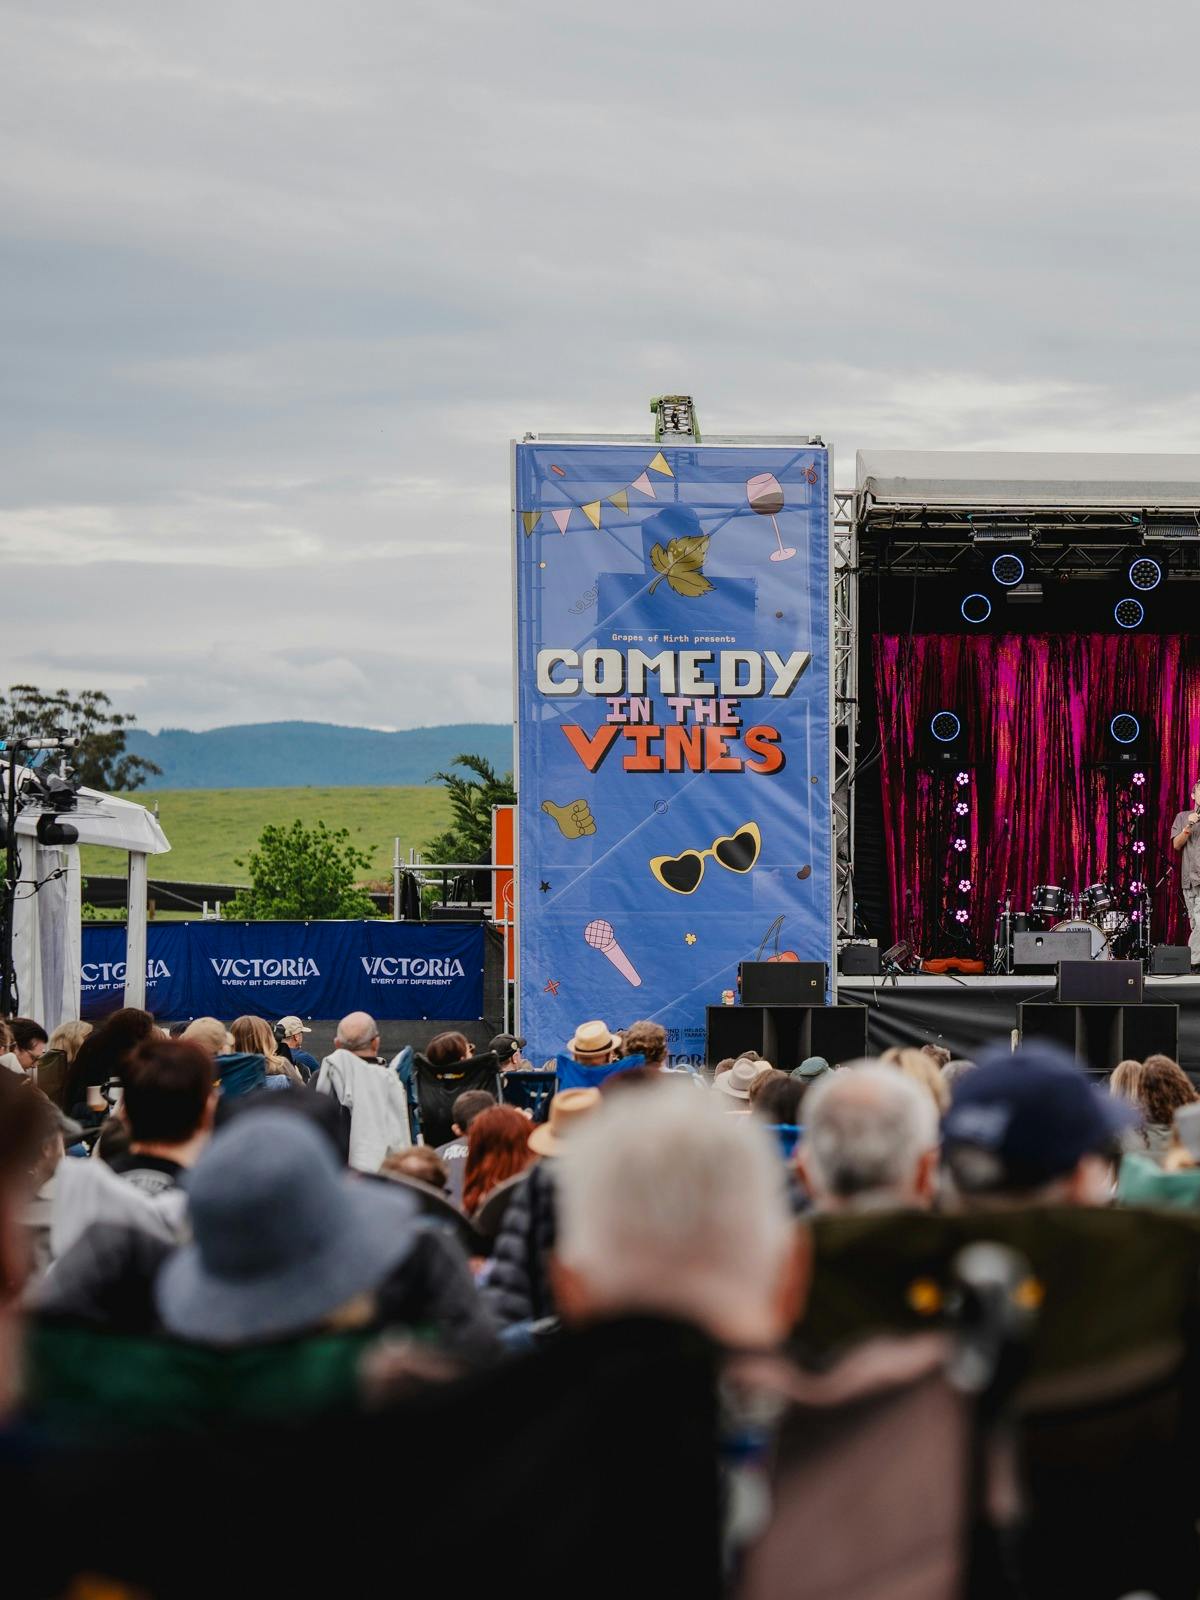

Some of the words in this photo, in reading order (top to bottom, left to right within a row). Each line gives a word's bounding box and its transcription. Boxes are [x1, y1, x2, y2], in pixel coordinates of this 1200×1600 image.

[611, 633, 644, 644] Grapes
[647, 634, 659, 643] of
[663, 634, 689, 644] Mirth
[694, 635, 737, 645] presents
[536, 648, 812, 697] COMEDY
[605, 697, 652, 723] IN
[667, 698, 741, 725] THE
[560, 724, 786, 774] VINES
